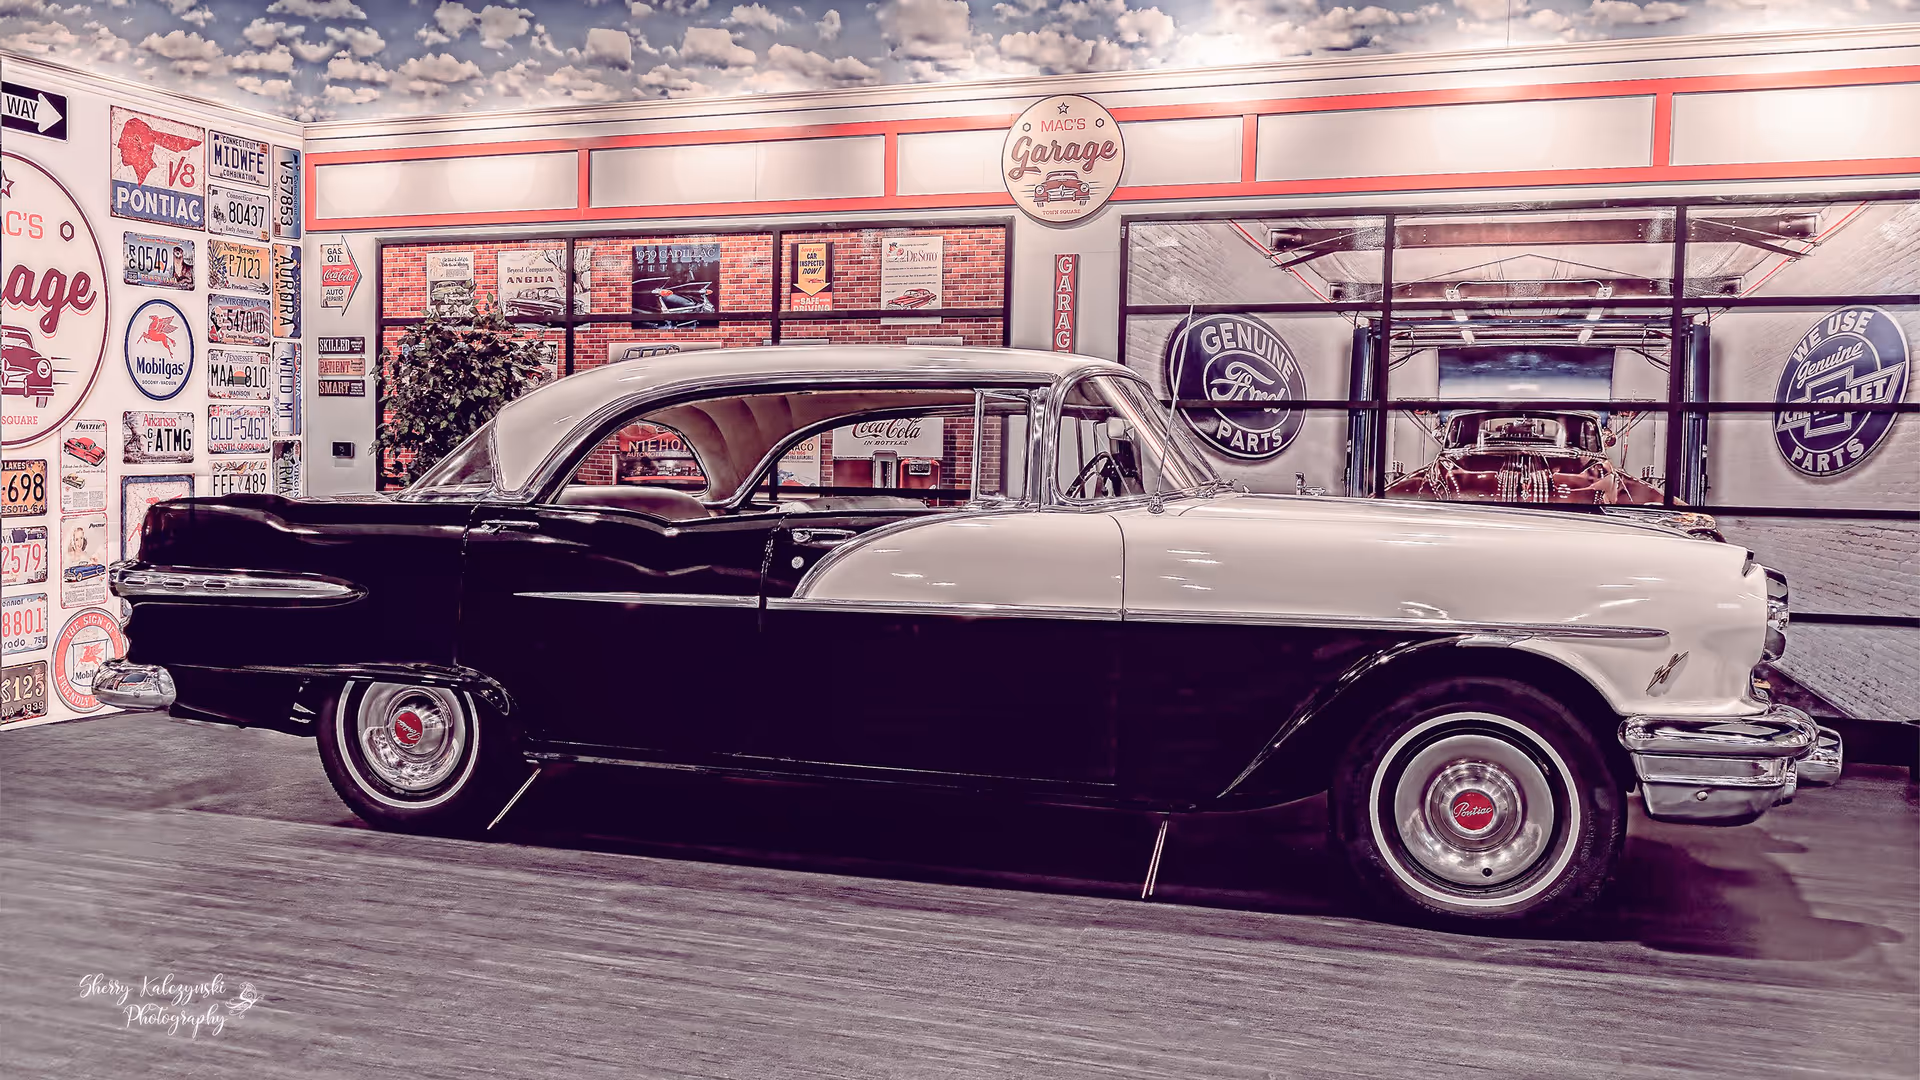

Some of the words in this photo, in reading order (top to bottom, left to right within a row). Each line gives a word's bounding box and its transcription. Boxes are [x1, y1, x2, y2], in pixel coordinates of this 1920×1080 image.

[6, 95, 38, 120] WAY
[1041, 118, 1086, 132] MAC'S
[223, 135, 256, 150] CONNECTICUT
[214, 143, 265, 175] MIDWFE
[1008, 135, 1118, 181] Garage
[168, 156, 195, 188] V8
[223, 169, 257, 182] COMBINATION
[116, 186, 201, 222] PONTIAC
[226, 191, 253, 202] Connecticut
[1, 210, 44, 240] C'S
[229, 201, 265, 228] 80437
[138, 246, 168, 273] 0549
[223, 242, 238, 252] New
[238, 244, 256, 258] Jersey
[327, 255, 341, 263] OIL
[635, 250, 657, 261] 1959
[659, 248, 716, 259] CADILLAC
[506, 266, 524, 275] Beyond
[525, 266, 554, 275] Comparison
[506, 275, 555, 284] ANGLIA
[800, 296, 820, 305] SAFE
[1056, 256, 1073, 353] GARAG
[319, 339, 350, 352] SKILLED
[1793, 327, 1821, 363] WE
[1827, 311, 1875, 335] USE
[1201, 322, 1294, 382] GENUINE
[136, 356, 184, 379] Mobilgas
[211, 364, 234, 387] MAA
[245, 365, 267, 388] 810
[279, 357, 293, 394] WILD
[319, 360, 350, 374] PATIENT
[1796, 341, 1864, 389] Genuine
[319, 381, 350, 395] SMART
[1210, 361, 1286, 413] Ford
[1, 416, 38, 425] SQUARE
[142, 413, 177, 427] Arkansas
[279, 402, 293, 420] MT
[155, 428, 191, 452] ATMG
[211, 417, 268, 440] CLD-5461
[1216, 420, 1283, 452] PARTS
[4, 461, 26, 470] LAKES
[1791, 438, 1865, 471] PARTS
[8, 473, 44, 502] 698
[245, 473, 267, 494] 489
[1, 543, 41, 574] 2579
[2, 607, 44, 638] 8801
[64, 621, 81, 640] THE
[83, 615, 104, 626] SIGN
[105, 622, 116, 634] OF
[3, 638, 26, 650] rado
[58, 674, 89, 706] FRIENDLY
[21, 700, 44, 714] 1939
[1453, 801, 1493, 818] Pontiac
